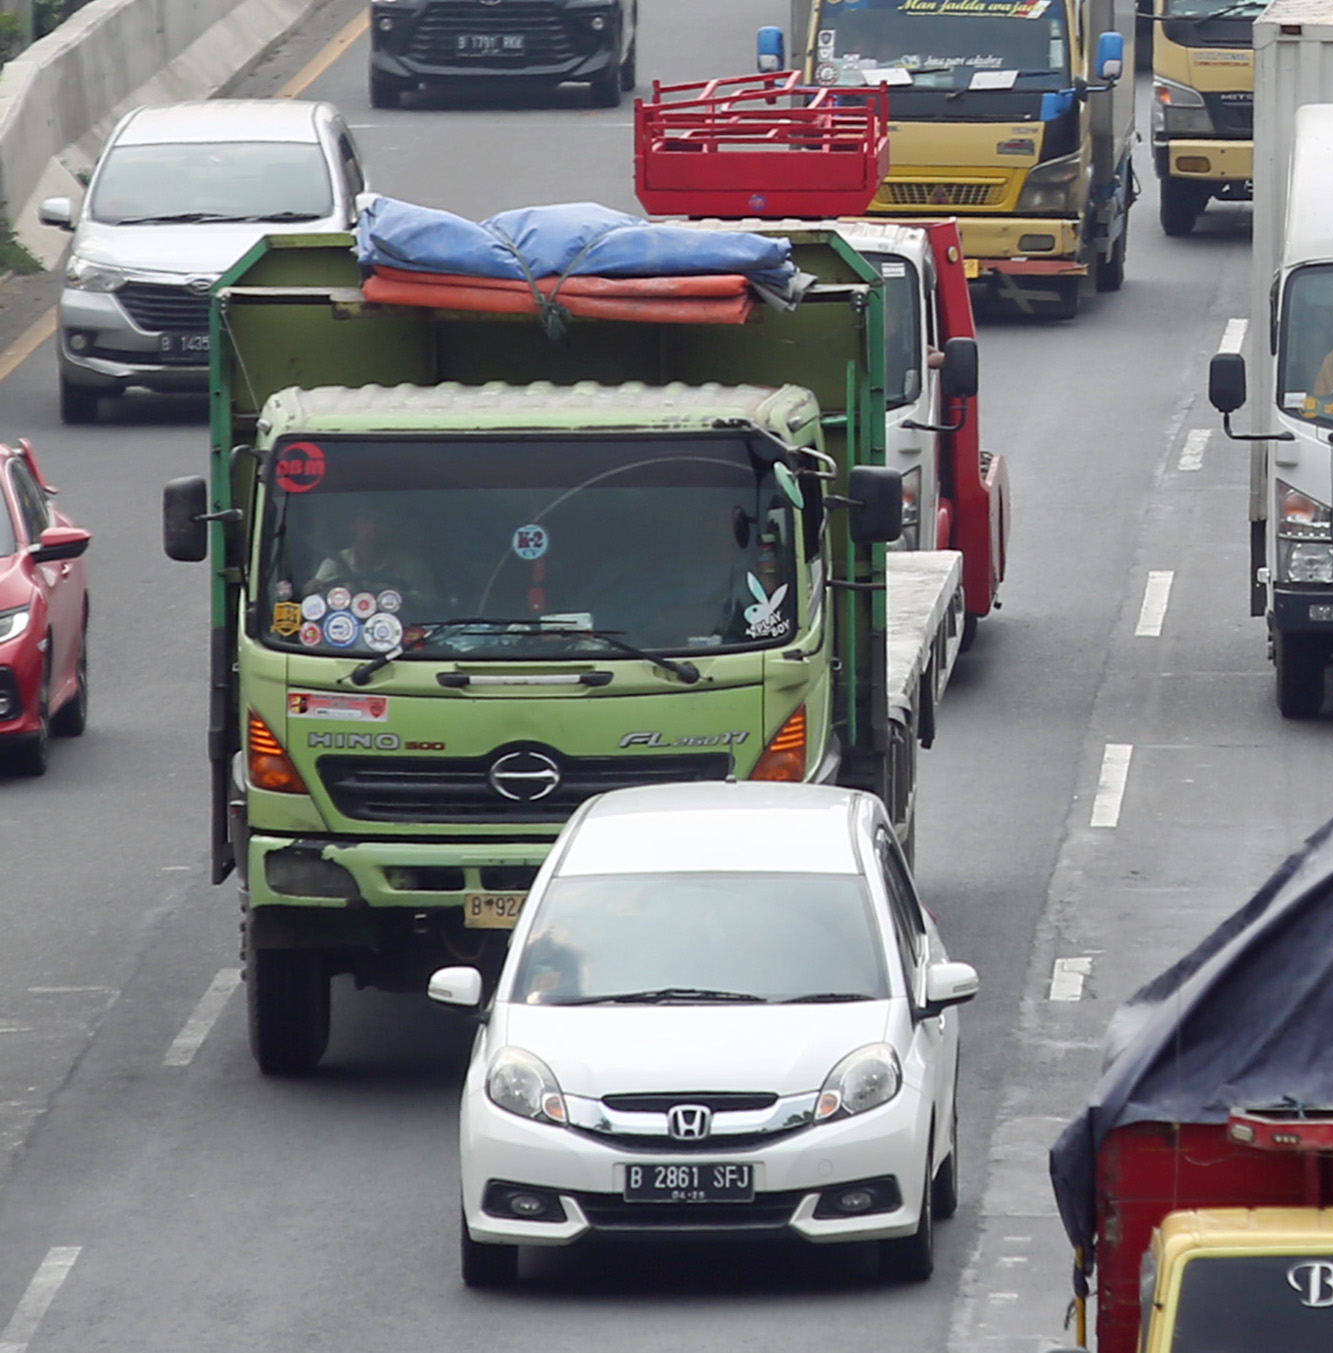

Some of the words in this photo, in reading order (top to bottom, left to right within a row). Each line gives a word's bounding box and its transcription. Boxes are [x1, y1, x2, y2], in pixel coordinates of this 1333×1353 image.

[162, 336, 171, 351] B
[517, 531, 544, 548] K-2
[756, 610, 781, 634] PLAY
[771, 619, 790, 637] BOY
[307, 731, 401, 751] HINO
[619, 731, 671, 748] FL
[472, 896, 482, 917] B
[630, 1166, 642, 1189] B
[654, 1165, 698, 1189] 2861
[713, 1165, 749, 1189] SFJ
